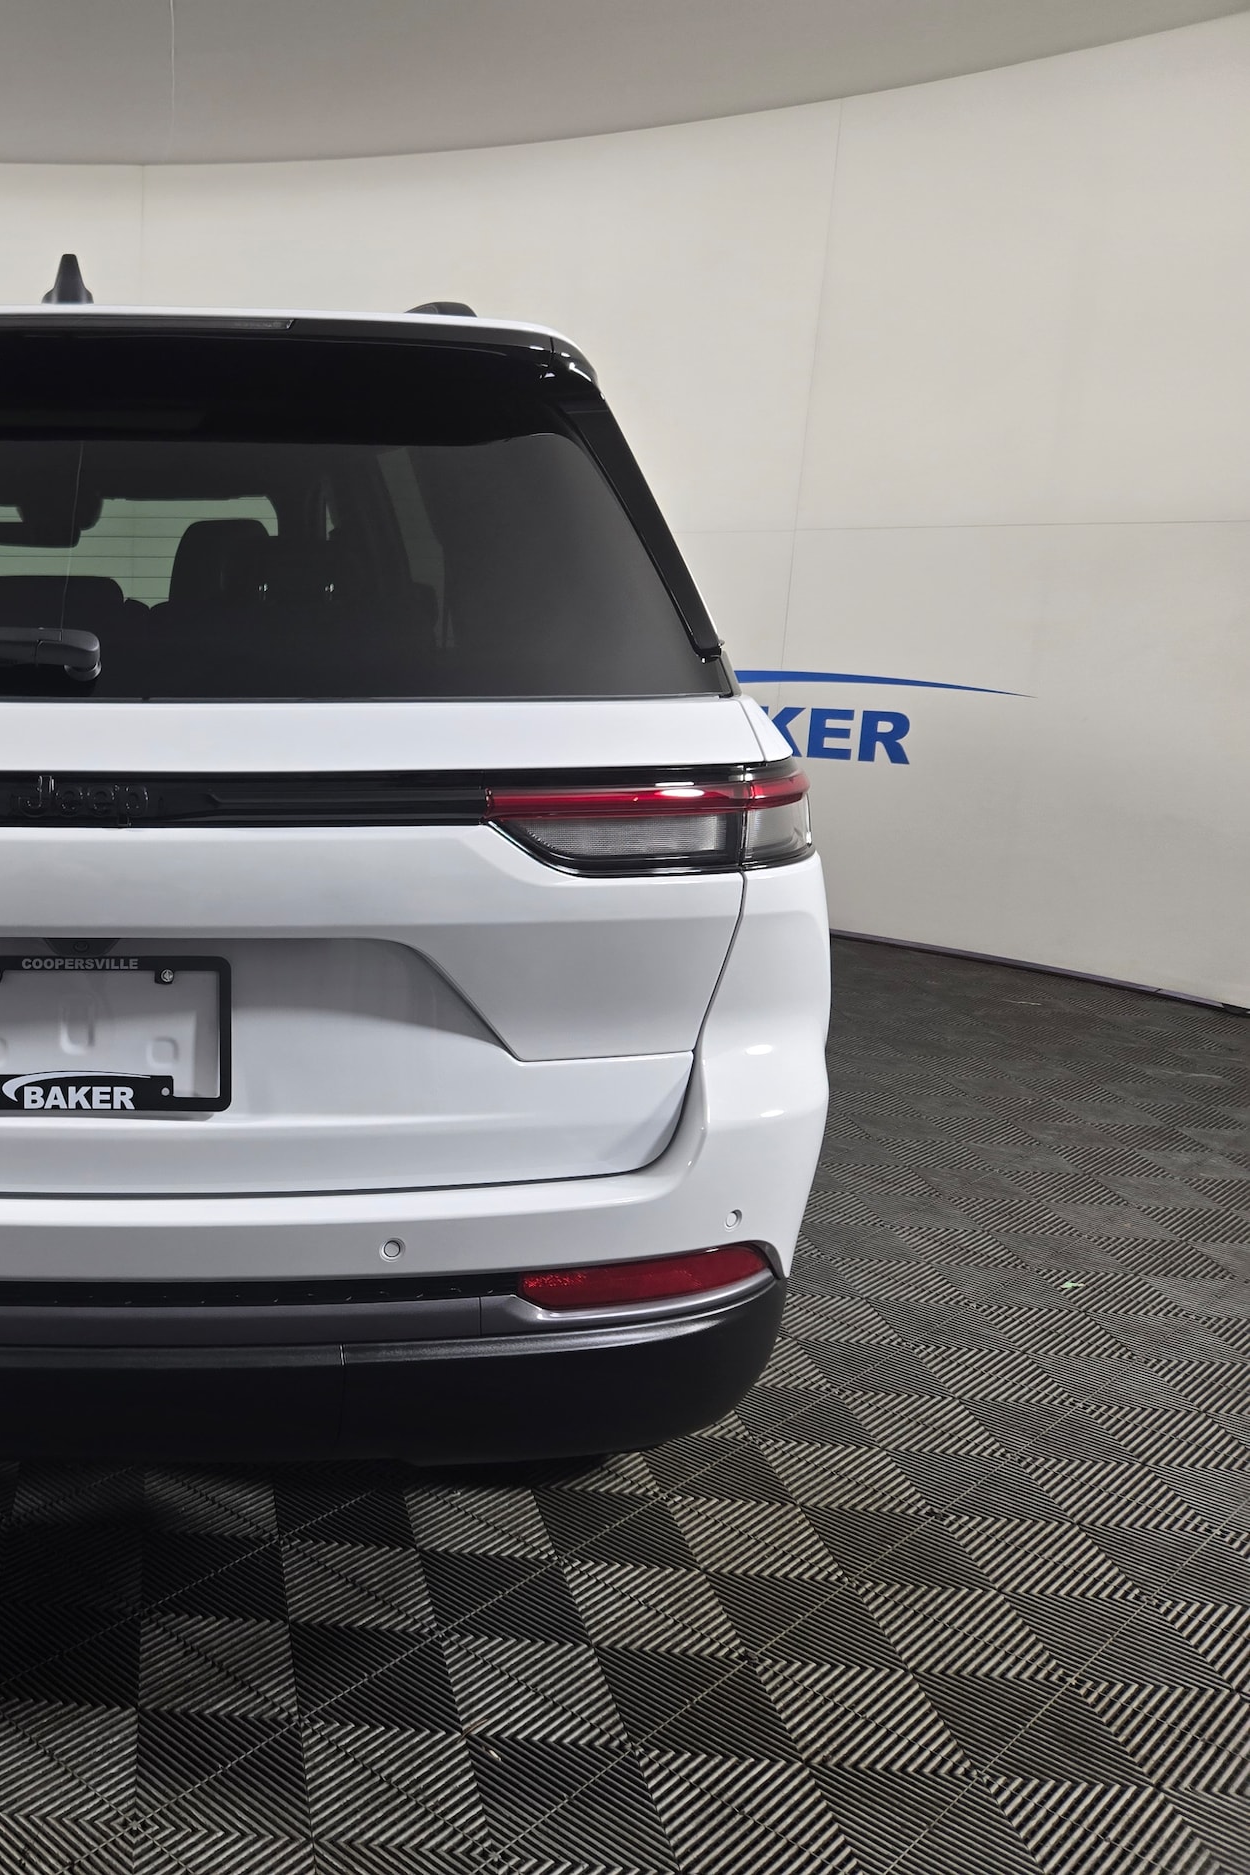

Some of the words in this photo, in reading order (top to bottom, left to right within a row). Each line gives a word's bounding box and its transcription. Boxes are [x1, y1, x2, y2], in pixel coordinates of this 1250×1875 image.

[18, 775, 149, 827] Jeep
[22, 958, 139, 970] COOPERSVILLE
[23, 1086, 136, 1110] BAKER
